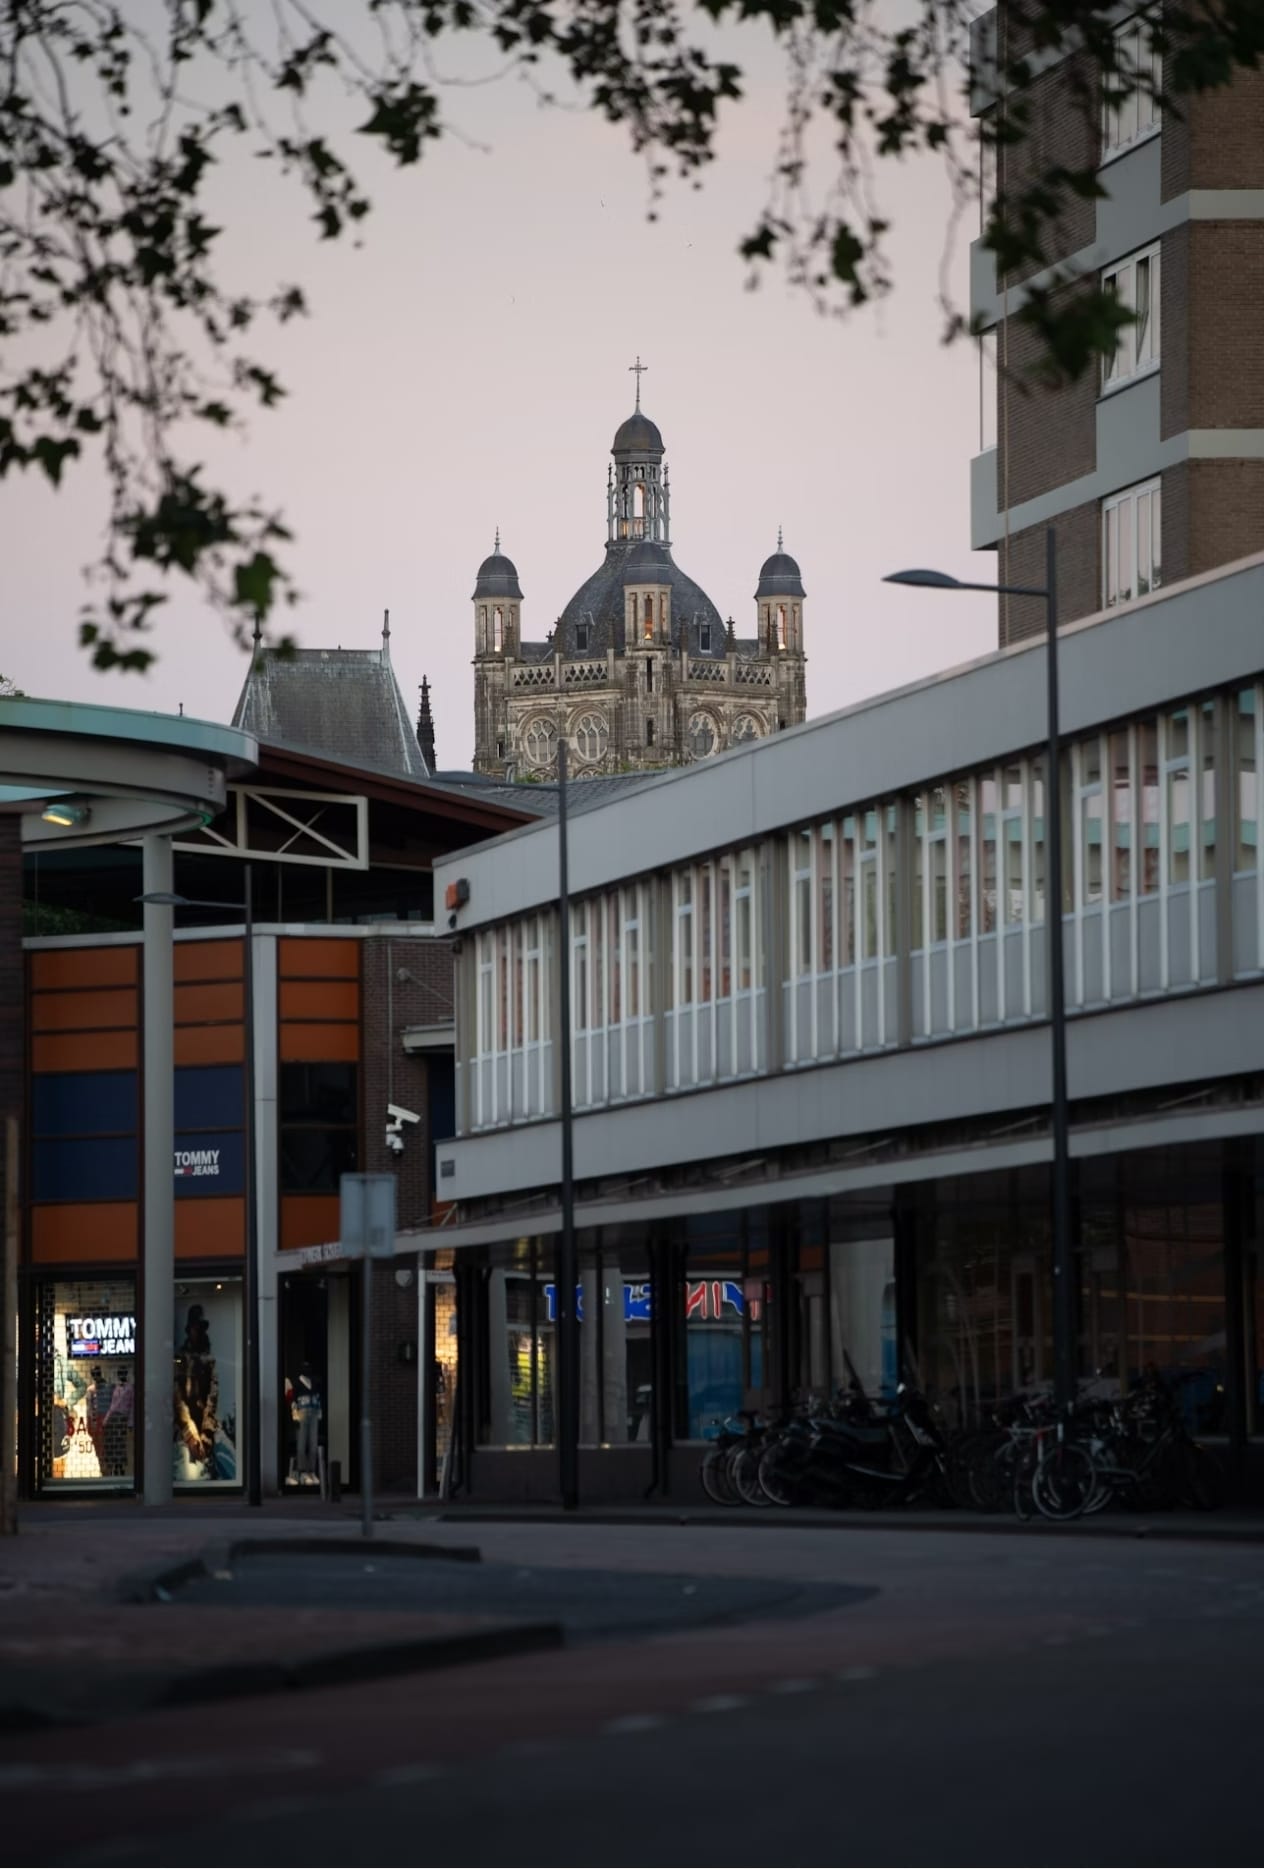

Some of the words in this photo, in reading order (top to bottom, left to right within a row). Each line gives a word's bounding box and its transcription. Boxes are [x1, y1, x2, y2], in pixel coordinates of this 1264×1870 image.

[174, 1149, 220, 1166] TOMMY
[192, 1164, 220, 1176] JEANS
[100, 1339, 136, 1354] JEAN
